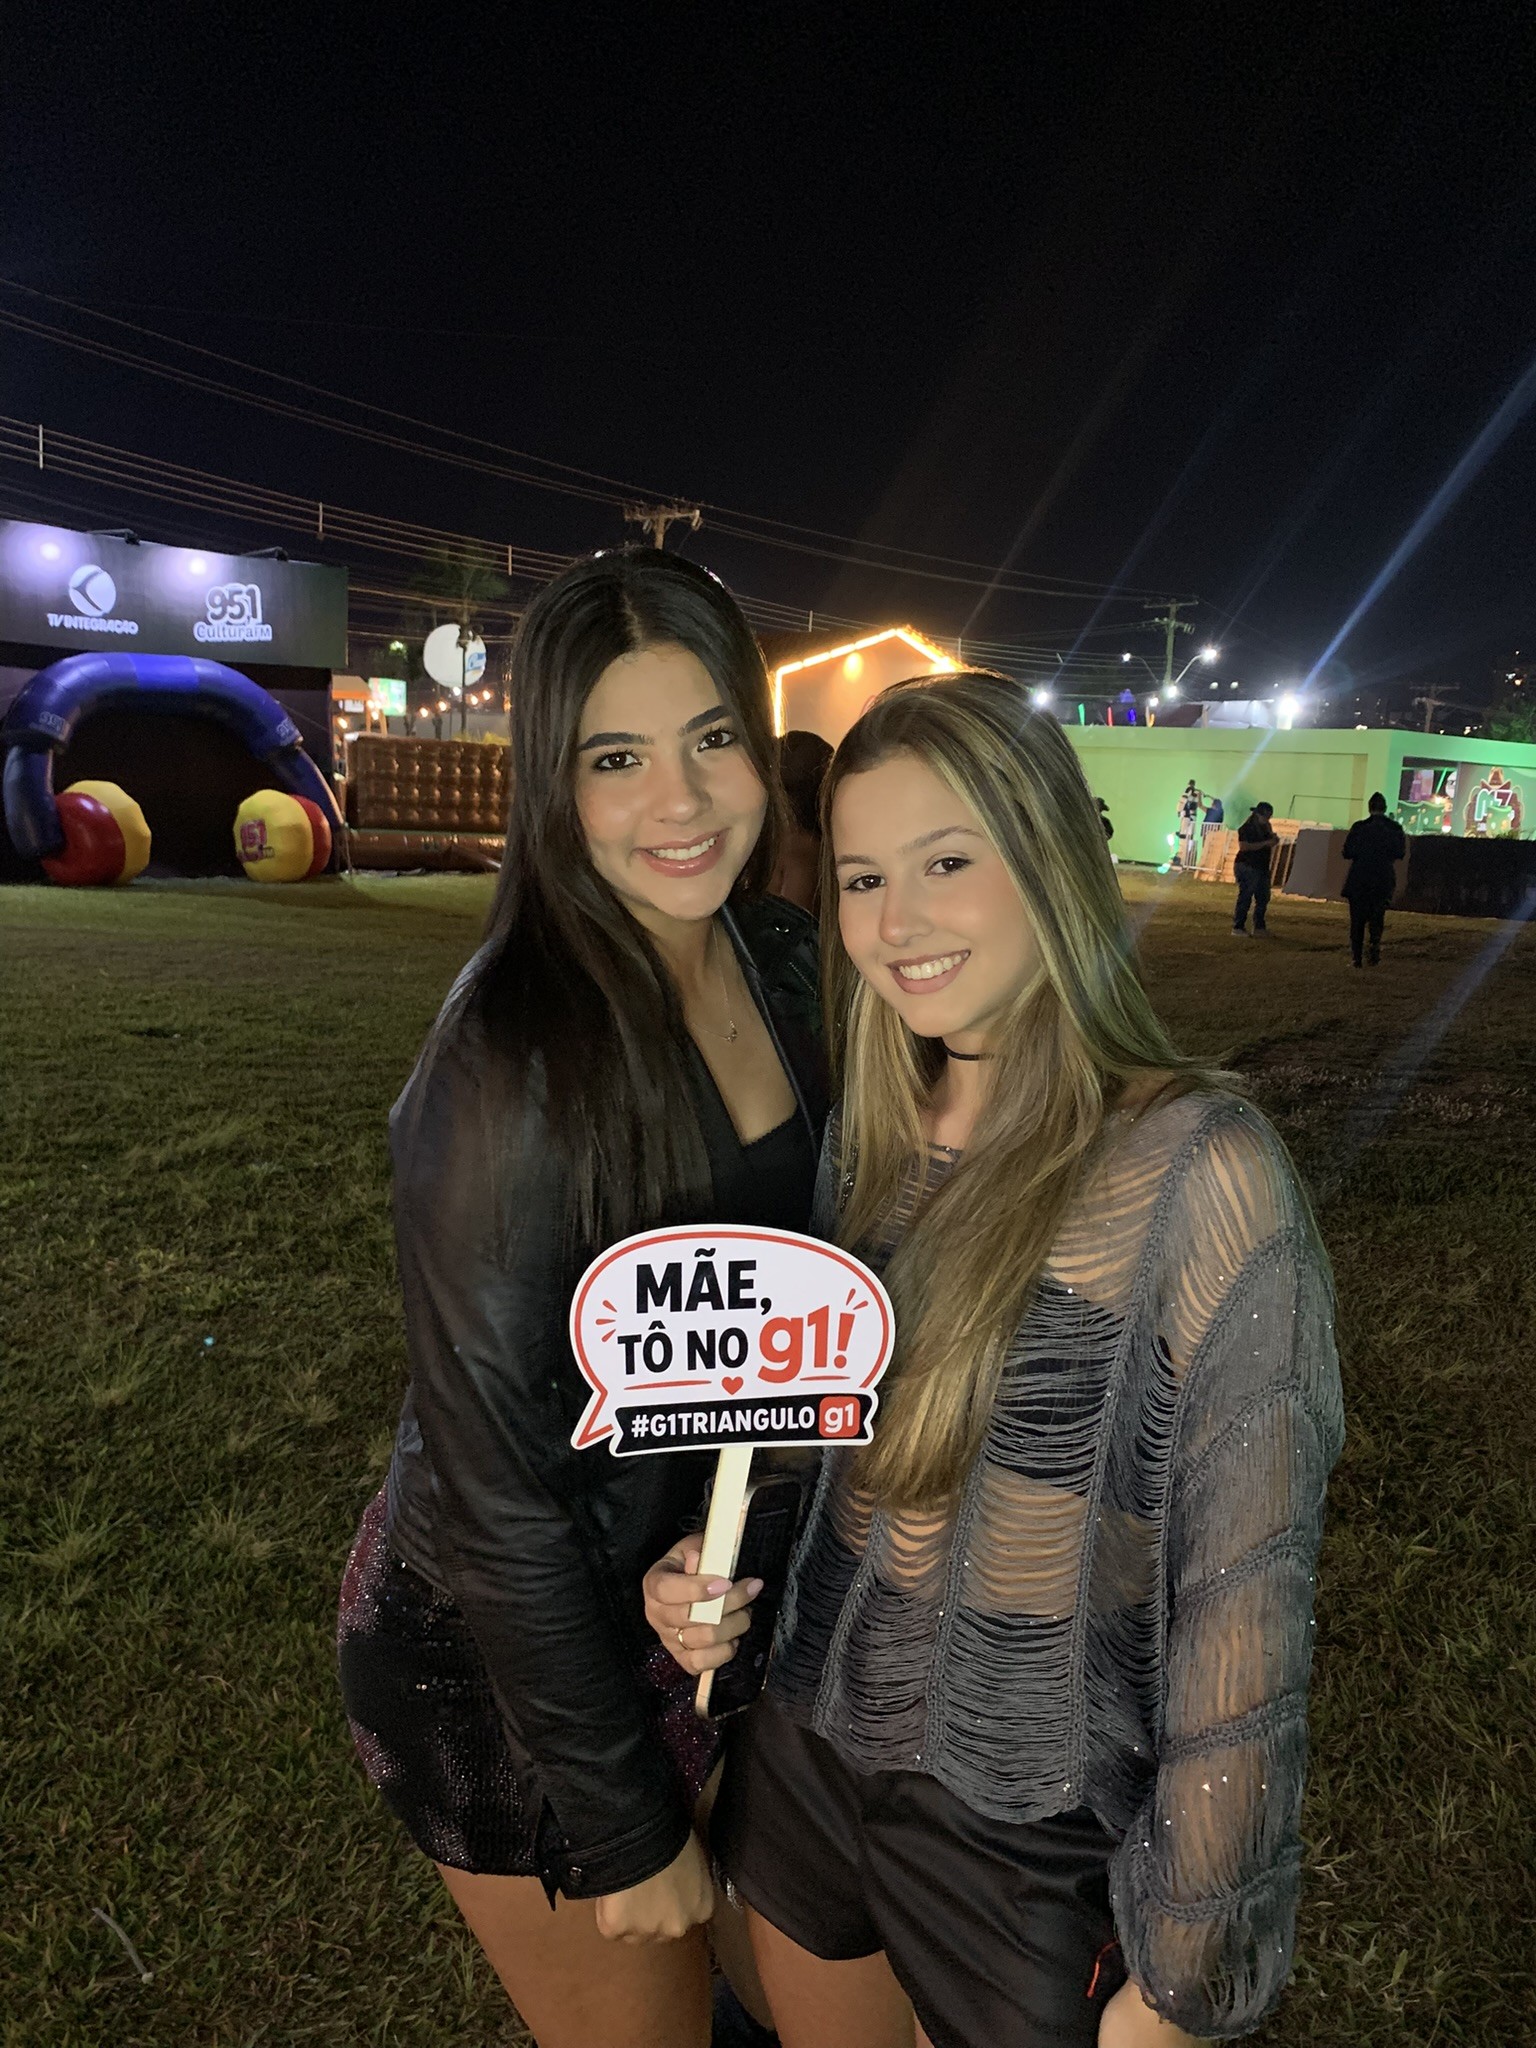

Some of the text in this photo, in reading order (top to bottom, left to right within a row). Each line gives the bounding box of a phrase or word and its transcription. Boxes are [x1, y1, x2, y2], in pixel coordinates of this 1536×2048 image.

[46, 613, 64, 628] TV
[636, 1248, 772, 1315] MÃE,
[617, 1305, 856, 1384] TÔ NO g1!
[631, 1403, 855, 1438] #G1TRIANGULO g1
